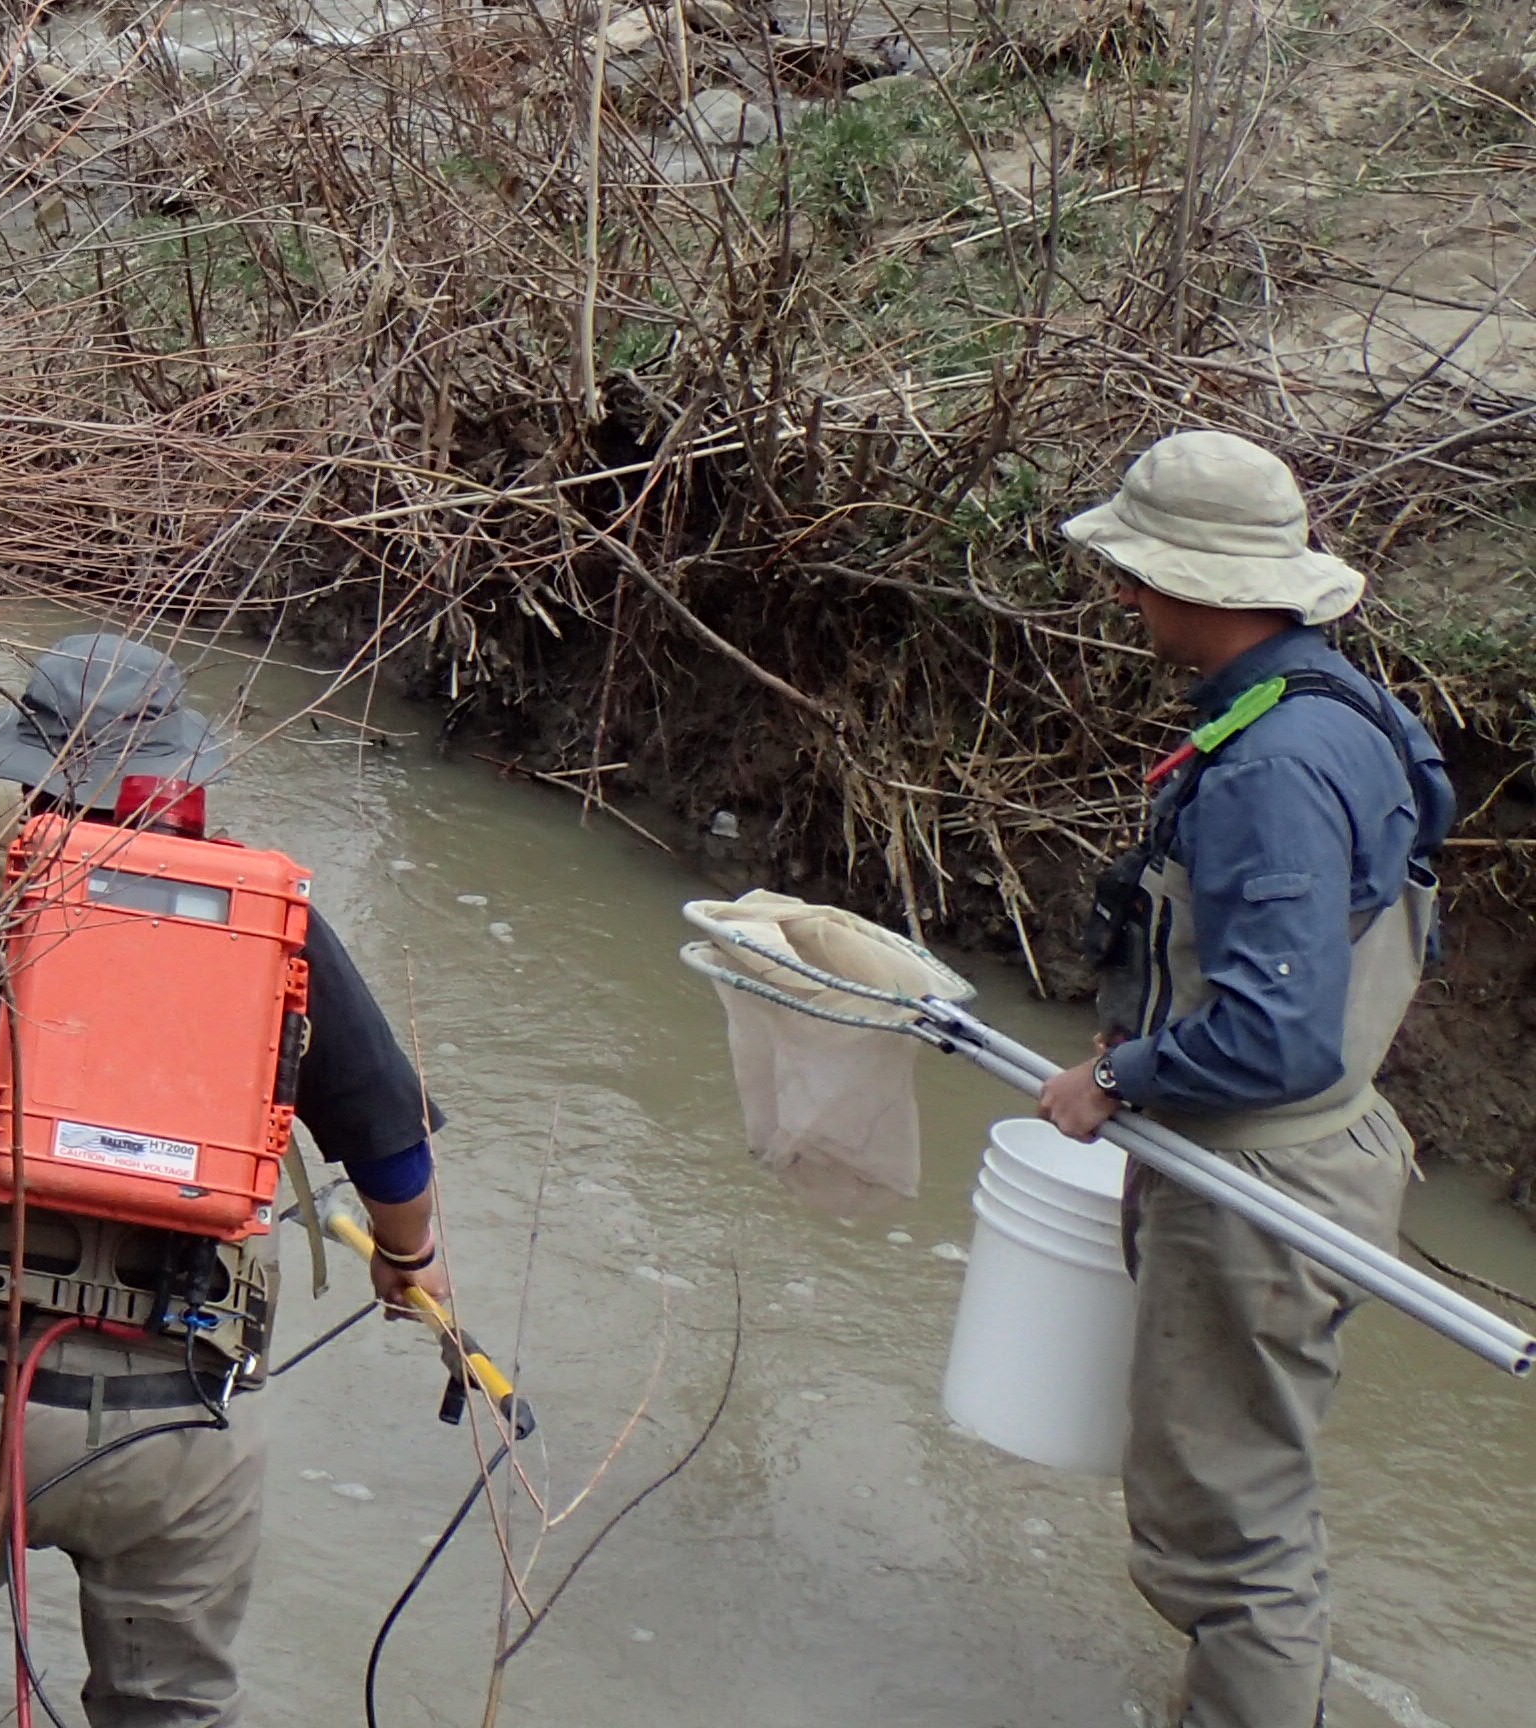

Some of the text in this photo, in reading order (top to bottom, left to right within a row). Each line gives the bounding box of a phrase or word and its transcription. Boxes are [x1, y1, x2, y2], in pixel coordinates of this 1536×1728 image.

[149, 1139, 195, 1156] HT2000
[59, 1147, 106, 1163] CAUTION
[115, 1158, 140, 1168] HIGH
[143, 1163, 191, 1177] VOLTAGE
